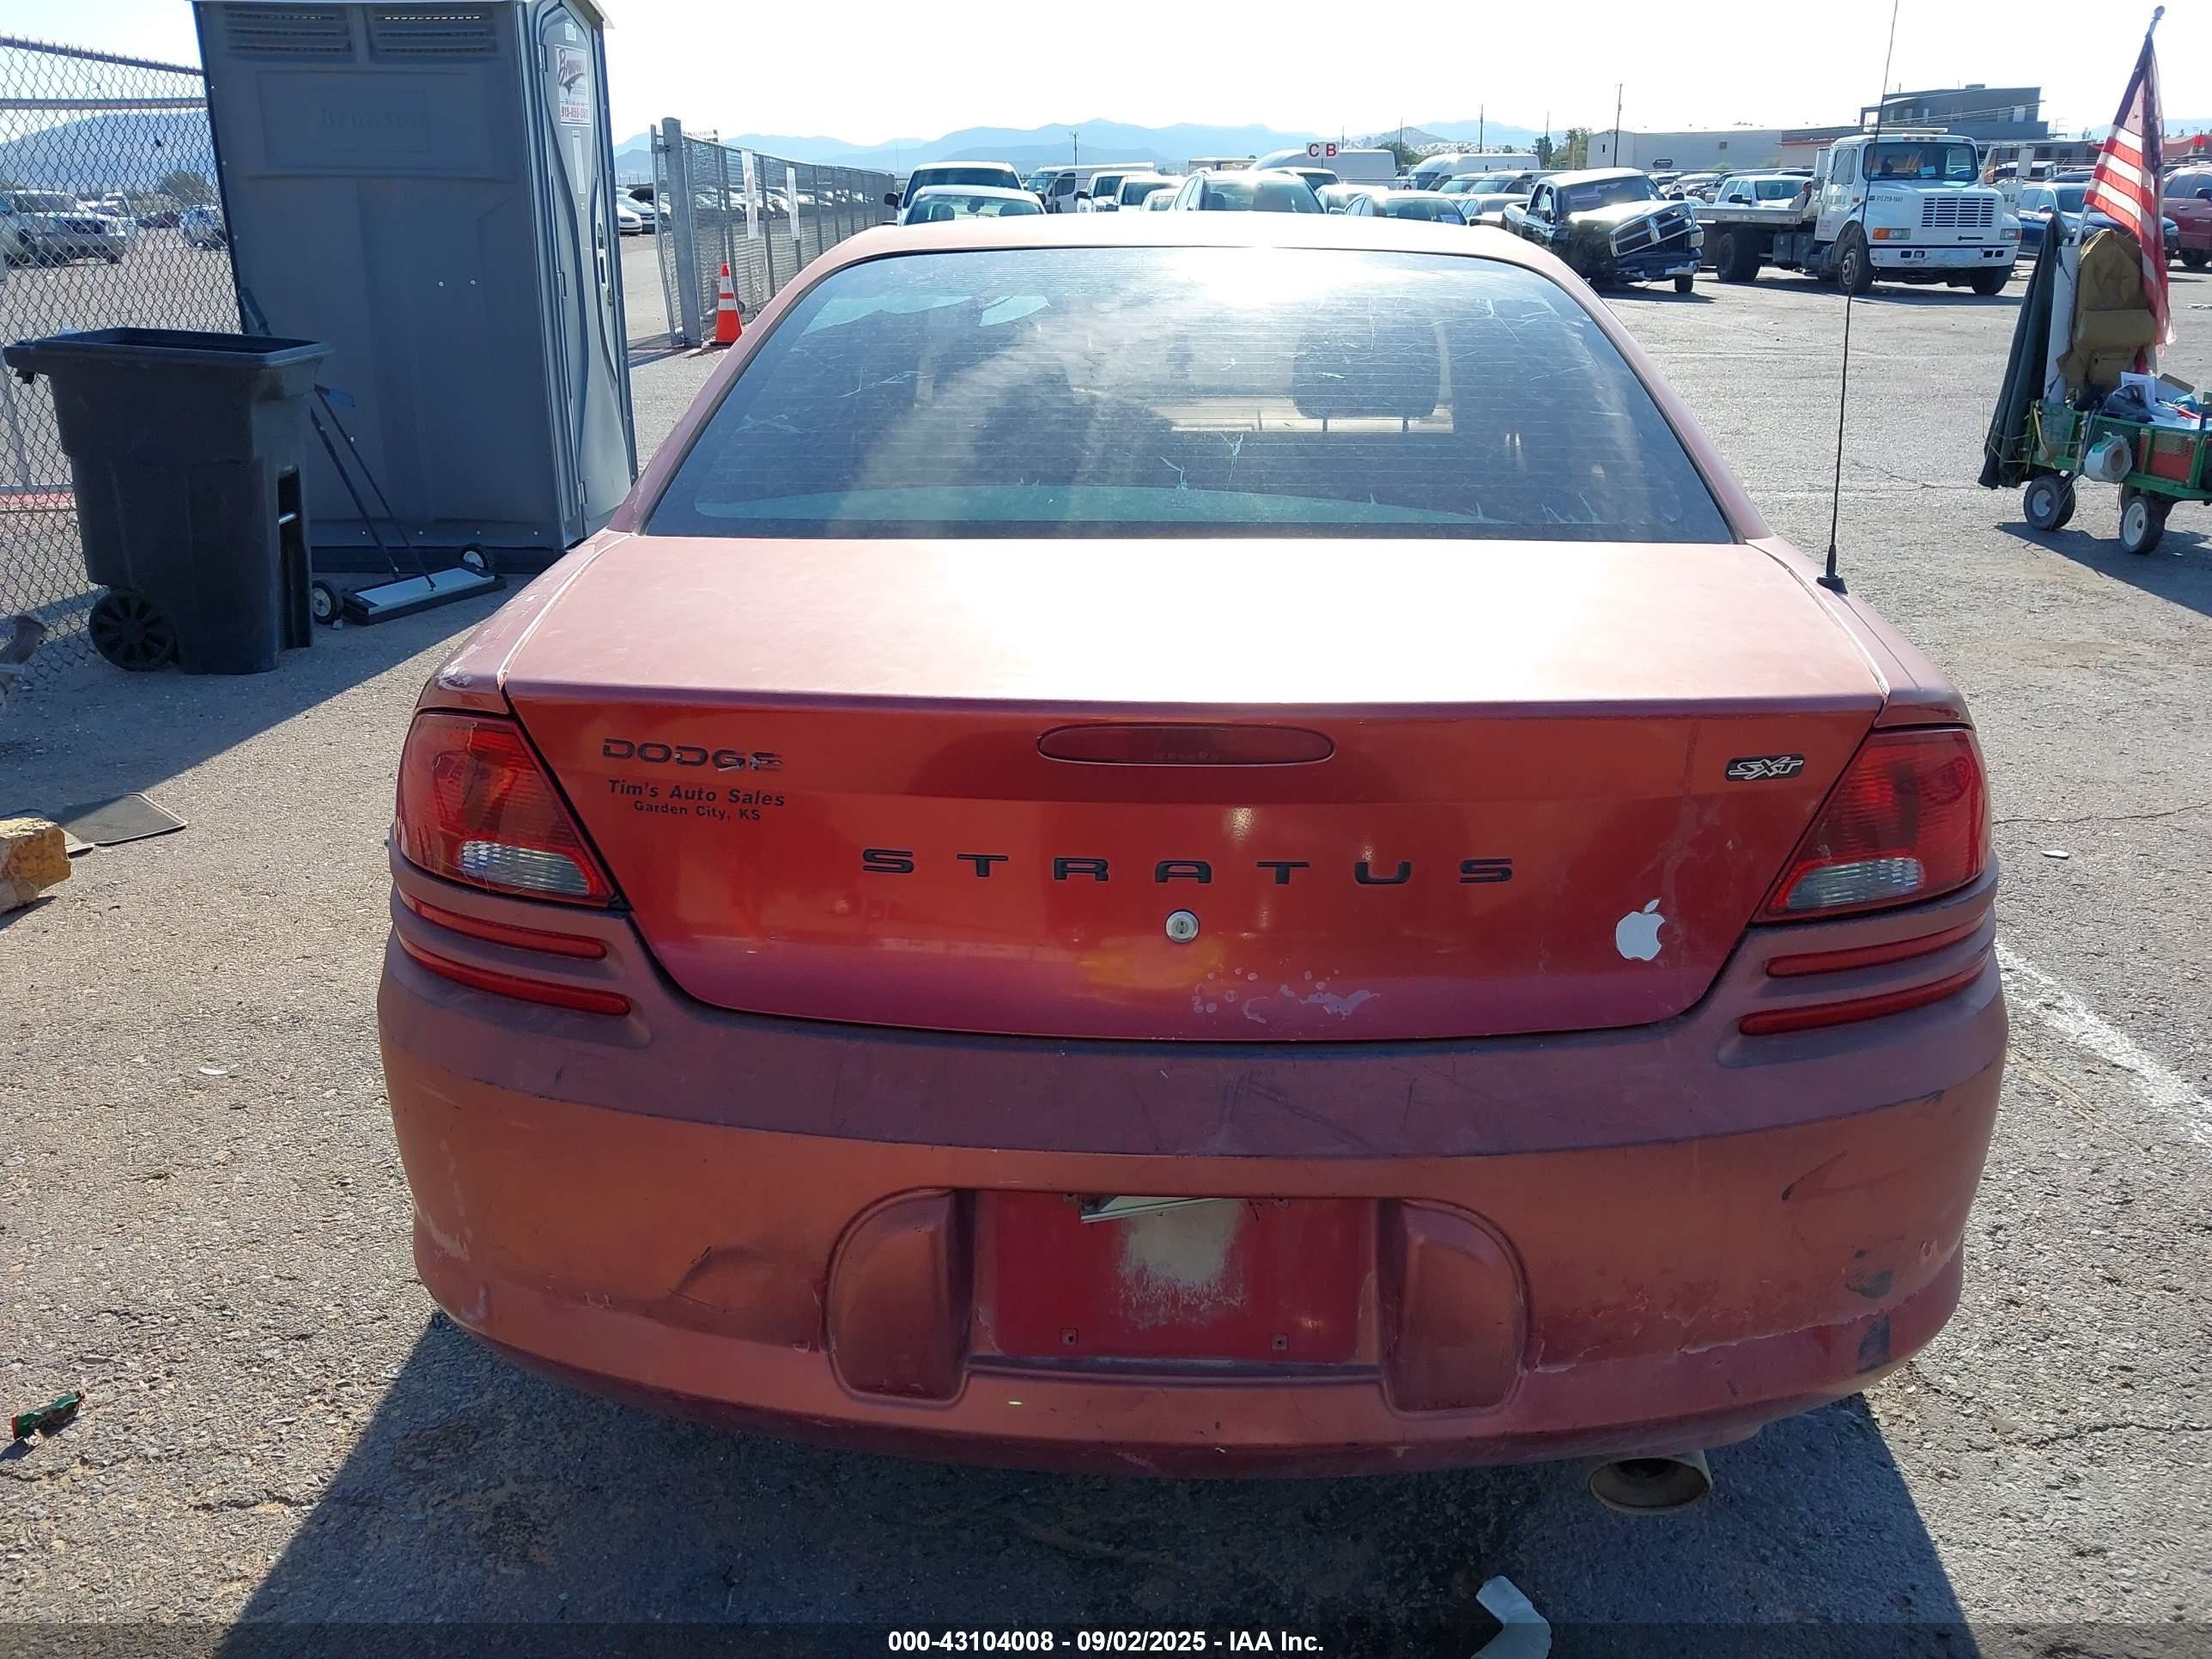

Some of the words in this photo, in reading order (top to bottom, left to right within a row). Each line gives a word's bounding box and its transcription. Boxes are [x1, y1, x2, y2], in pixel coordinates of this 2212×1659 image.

[603, 738, 783, 771] DODGE
[1728, 757, 1804, 780] SXT
[609, 779, 659, 798] Tim's
[670, 785, 716, 802] Auto
[727, 788, 786, 806] Sales
[634, 800, 688, 815] Garden
[696, 805, 731, 821] City,
[739, 809, 761, 820] KS
[862, 848, 1513, 884] STRATUS
